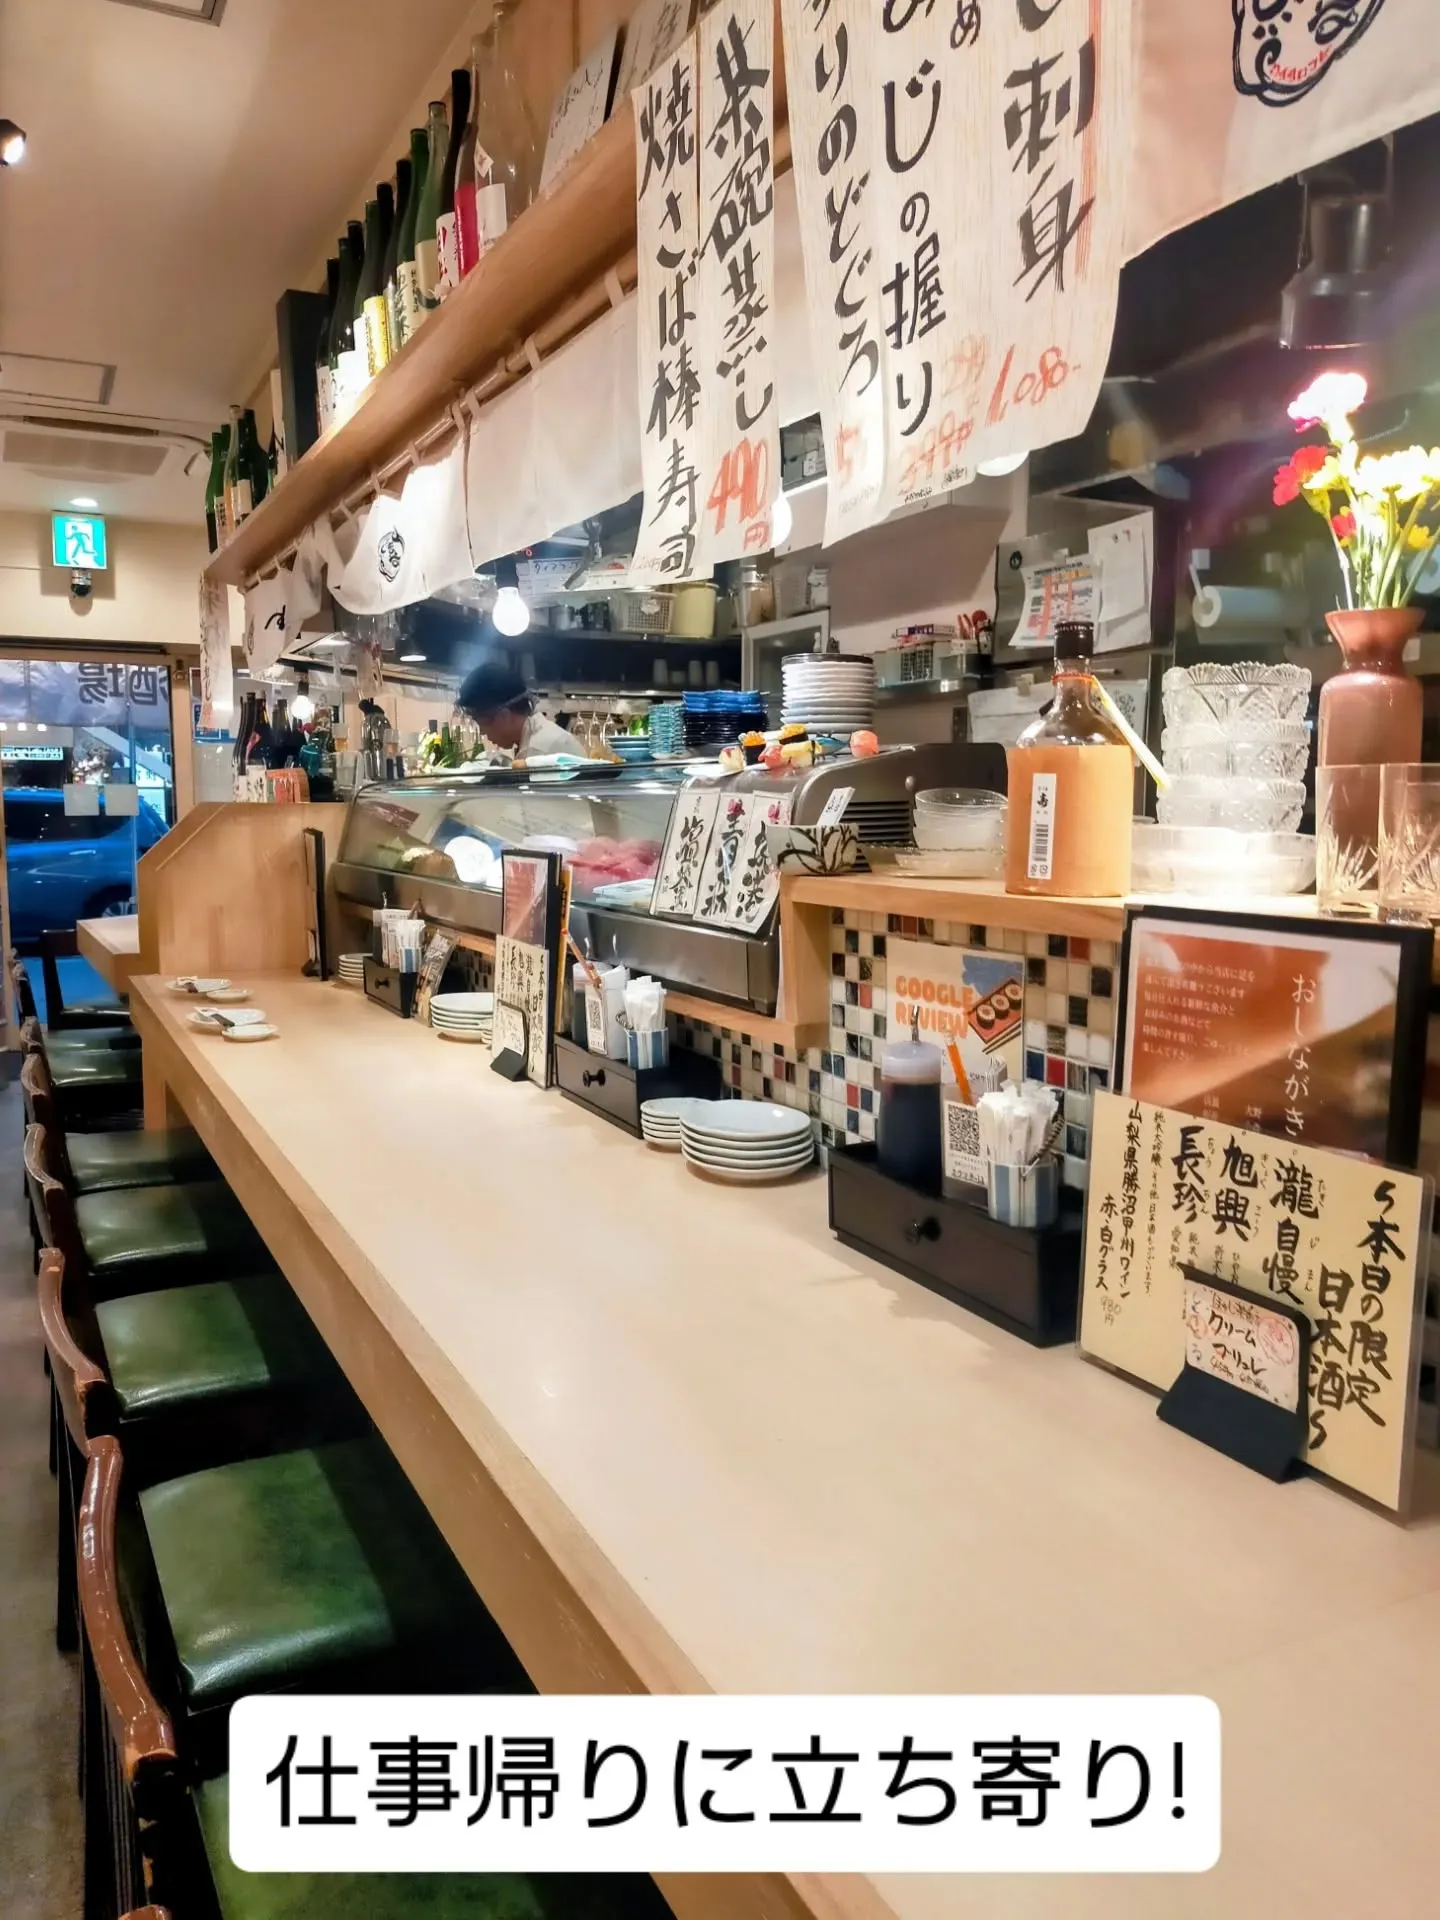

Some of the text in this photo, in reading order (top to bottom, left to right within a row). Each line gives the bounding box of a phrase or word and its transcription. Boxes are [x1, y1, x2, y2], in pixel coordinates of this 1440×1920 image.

[699, 14, 773, 431] 茶碗蒸し
[637, 58, 702, 578] 焼さば棒寿司
[895, 975, 976, 1011] GOOGLE
[1285, 973, 1316, 1137] おしながき
[1170, 1125, 1206, 1224] 長珍
[1211, 1133, 1258, 1242] 旭興
[1262, 1158, 1319, 1304] 瀧自慢
[1208, 1310, 1256, 1348] クリーム
